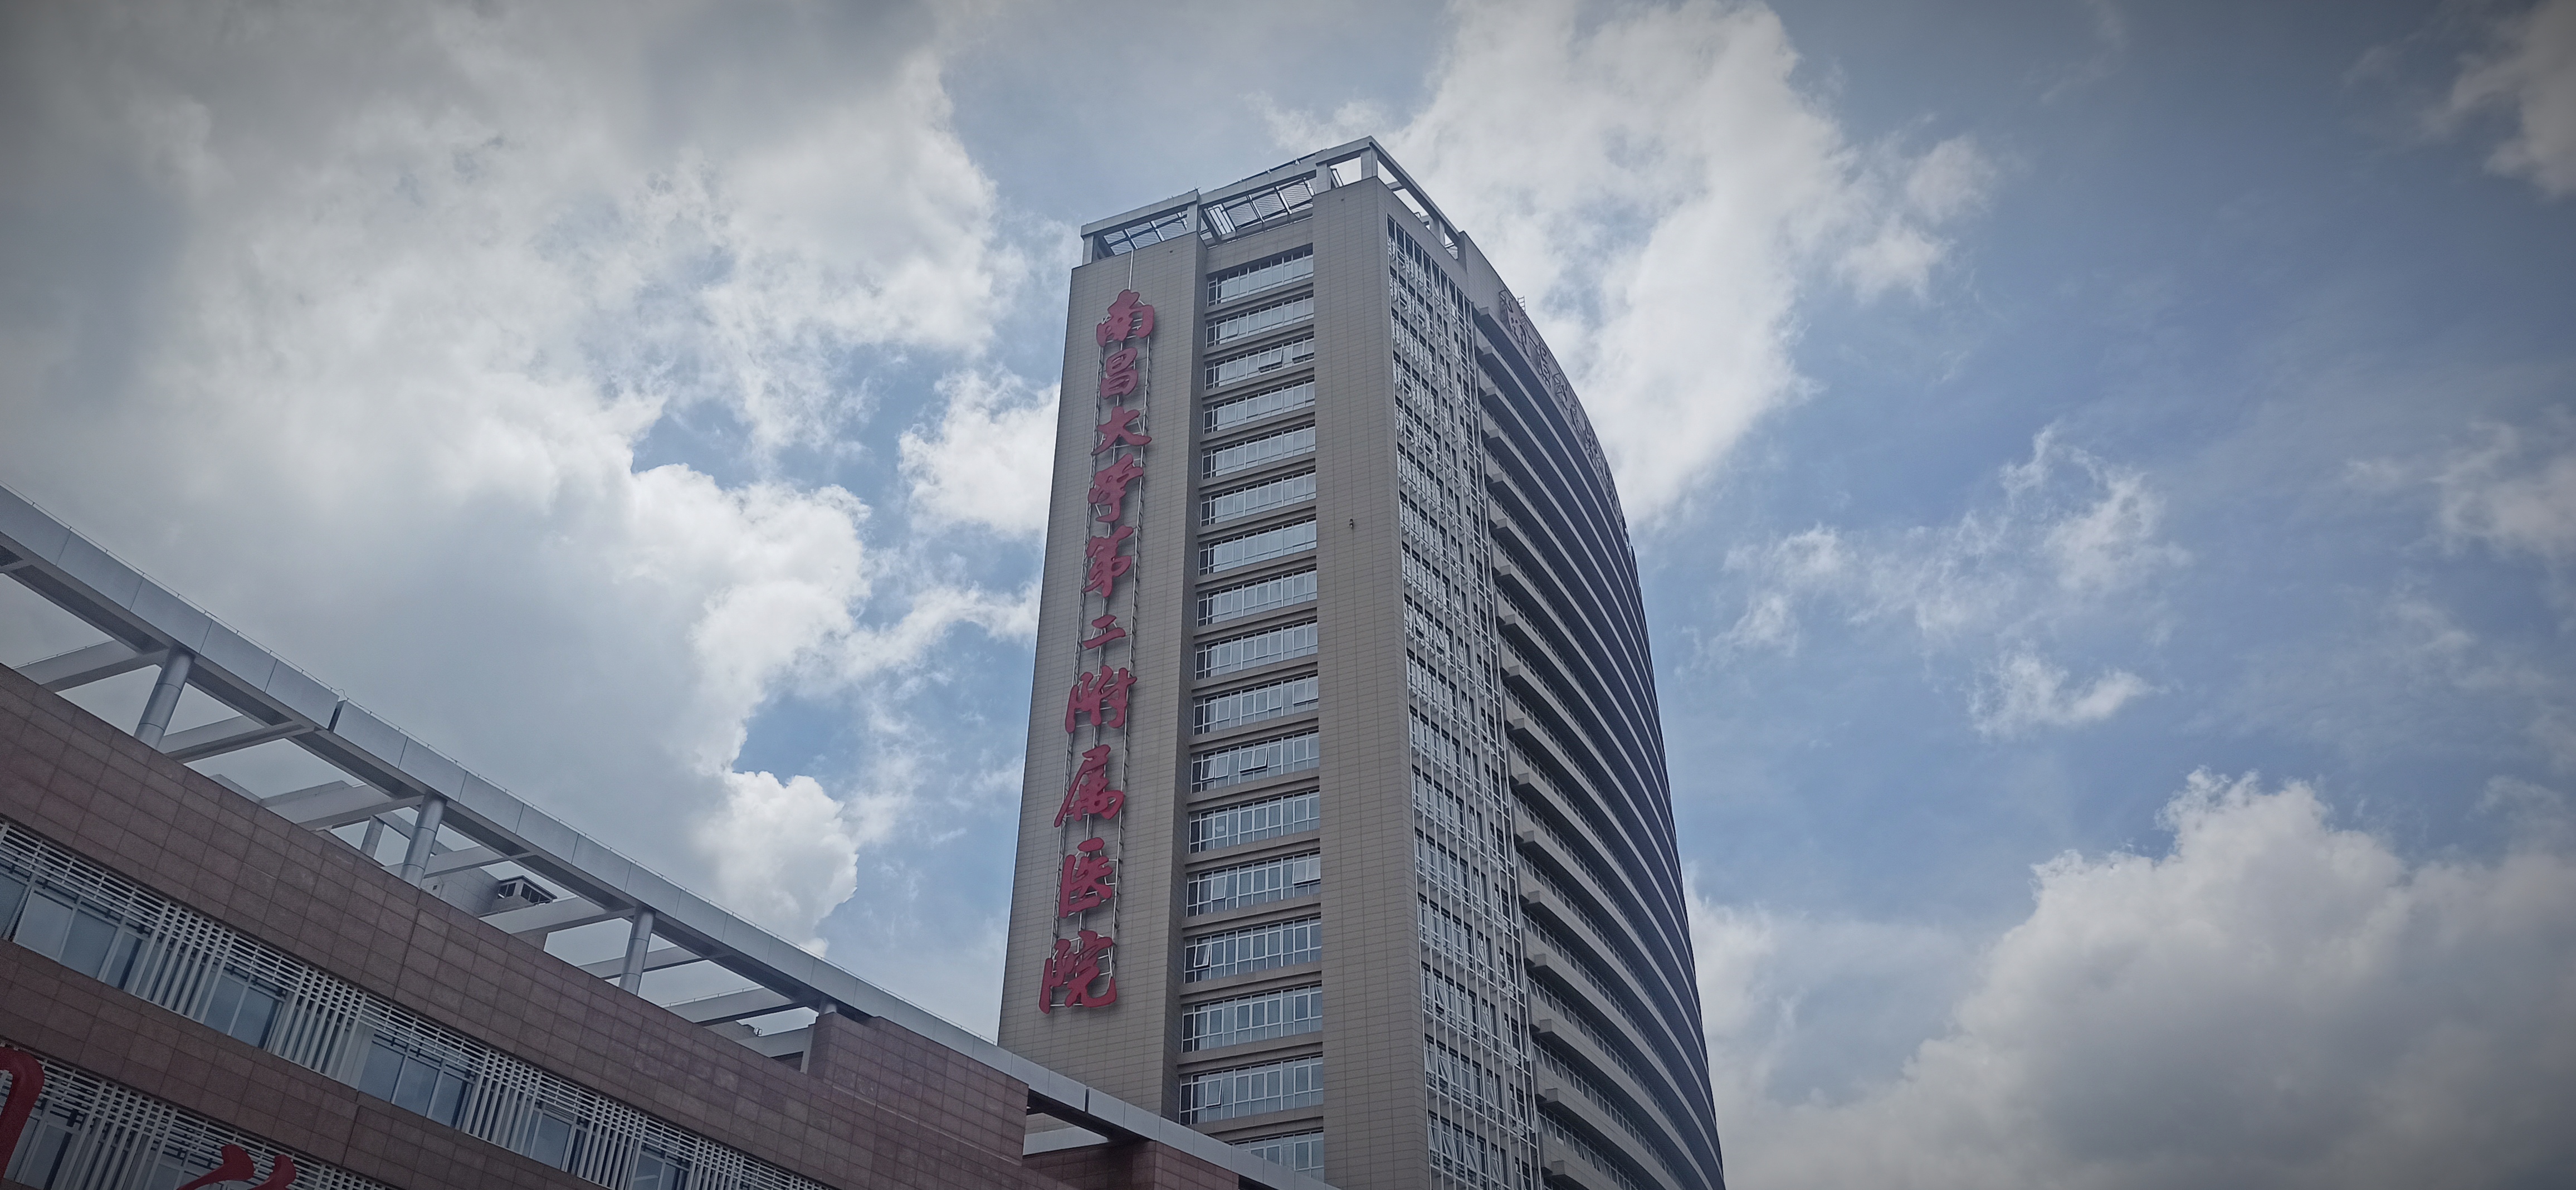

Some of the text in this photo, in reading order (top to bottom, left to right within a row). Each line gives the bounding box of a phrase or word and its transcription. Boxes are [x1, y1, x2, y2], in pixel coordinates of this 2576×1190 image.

[1038, 289, 1155, 1014] 南昌大学第二附属医院
